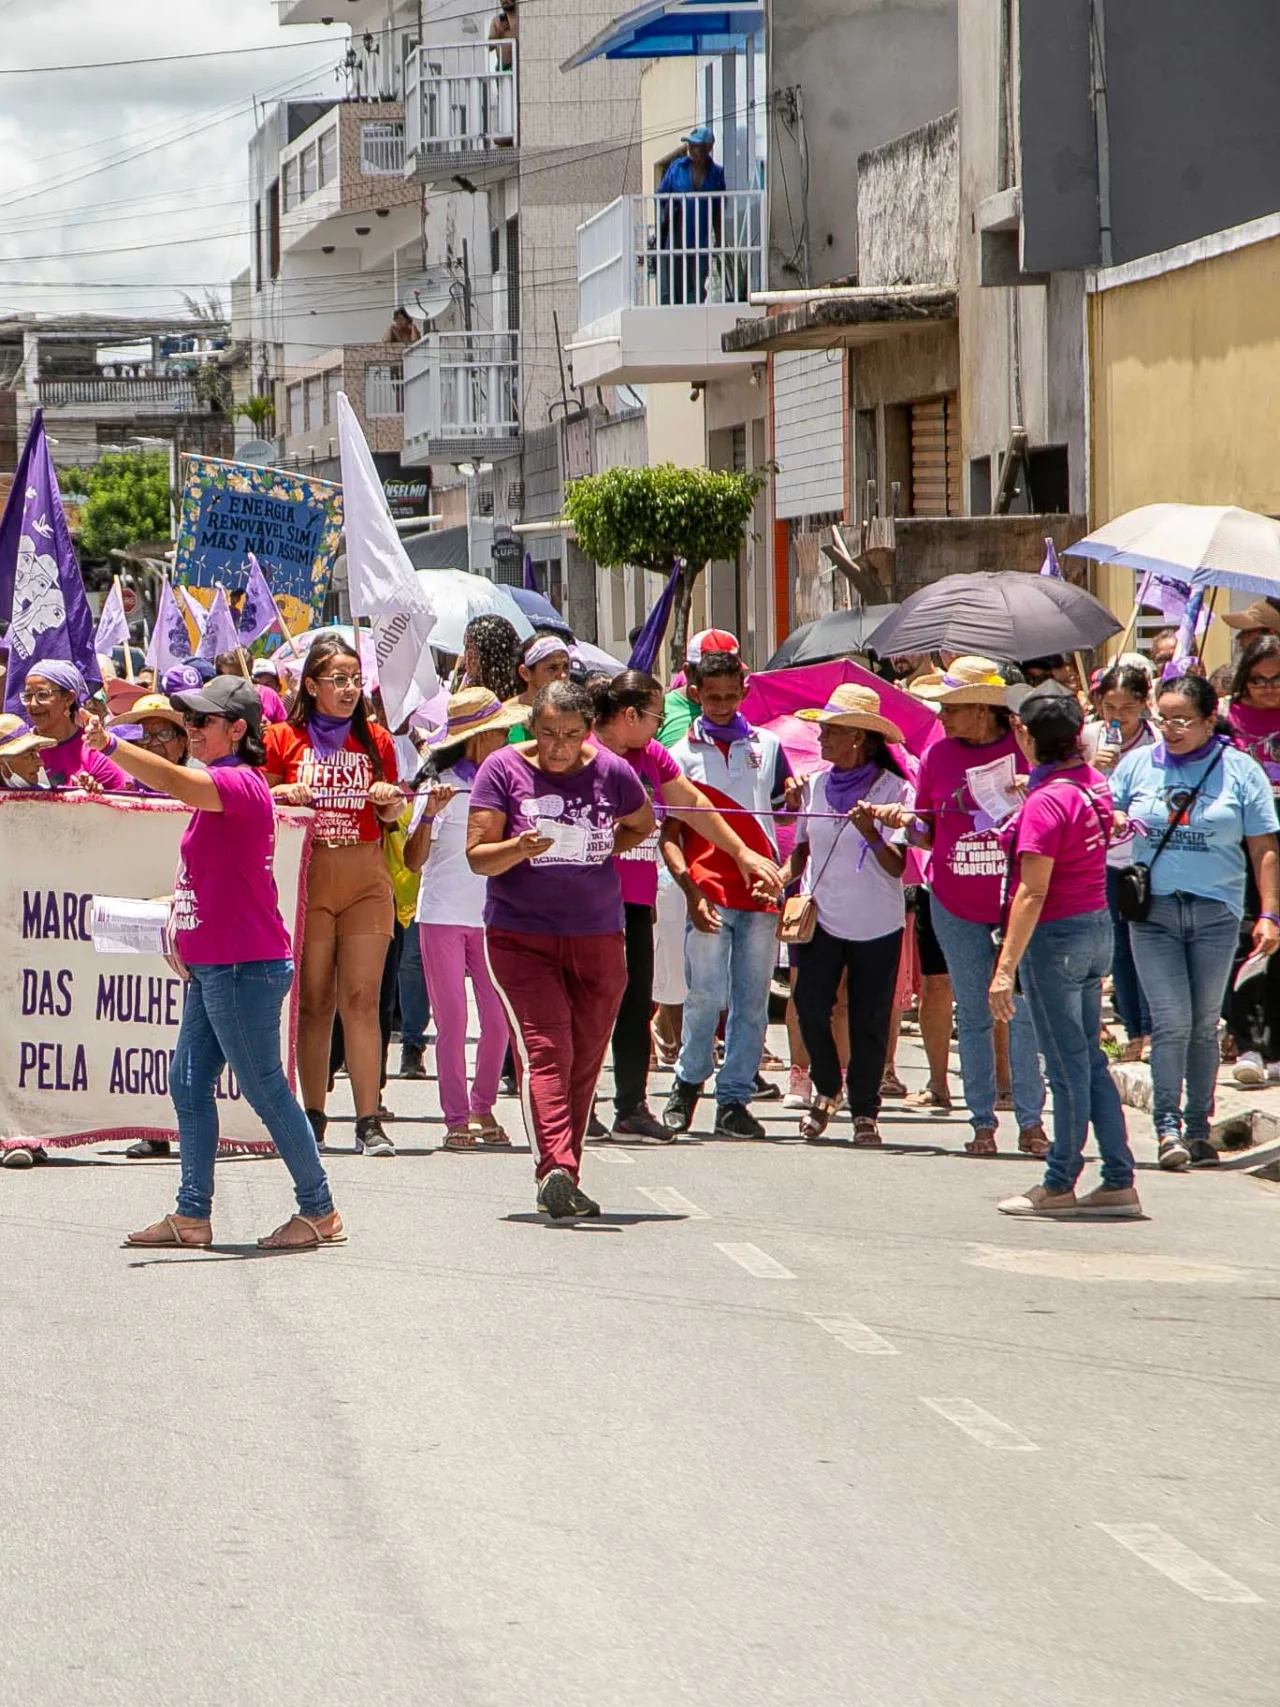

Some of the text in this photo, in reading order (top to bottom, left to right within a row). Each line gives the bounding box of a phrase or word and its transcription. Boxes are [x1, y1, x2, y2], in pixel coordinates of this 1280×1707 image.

[228, 496, 295, 523] ENERGIA
[207, 511, 317, 548] RENOVÁVEL SIM!
[200, 531, 315, 566] MAS NÃO ASSIM!
[494, 548, 520, 556] LUPO
[302, 764, 363, 789] DEFESA
[953, 860, 1005, 876] AGROECOLÓ
[969, 850, 1006, 862] BORBOR
[21, 890, 93, 941] MARC
[22, 968, 191, 1026] DAS MULHE
[18, 1041, 88, 1092] PELA
